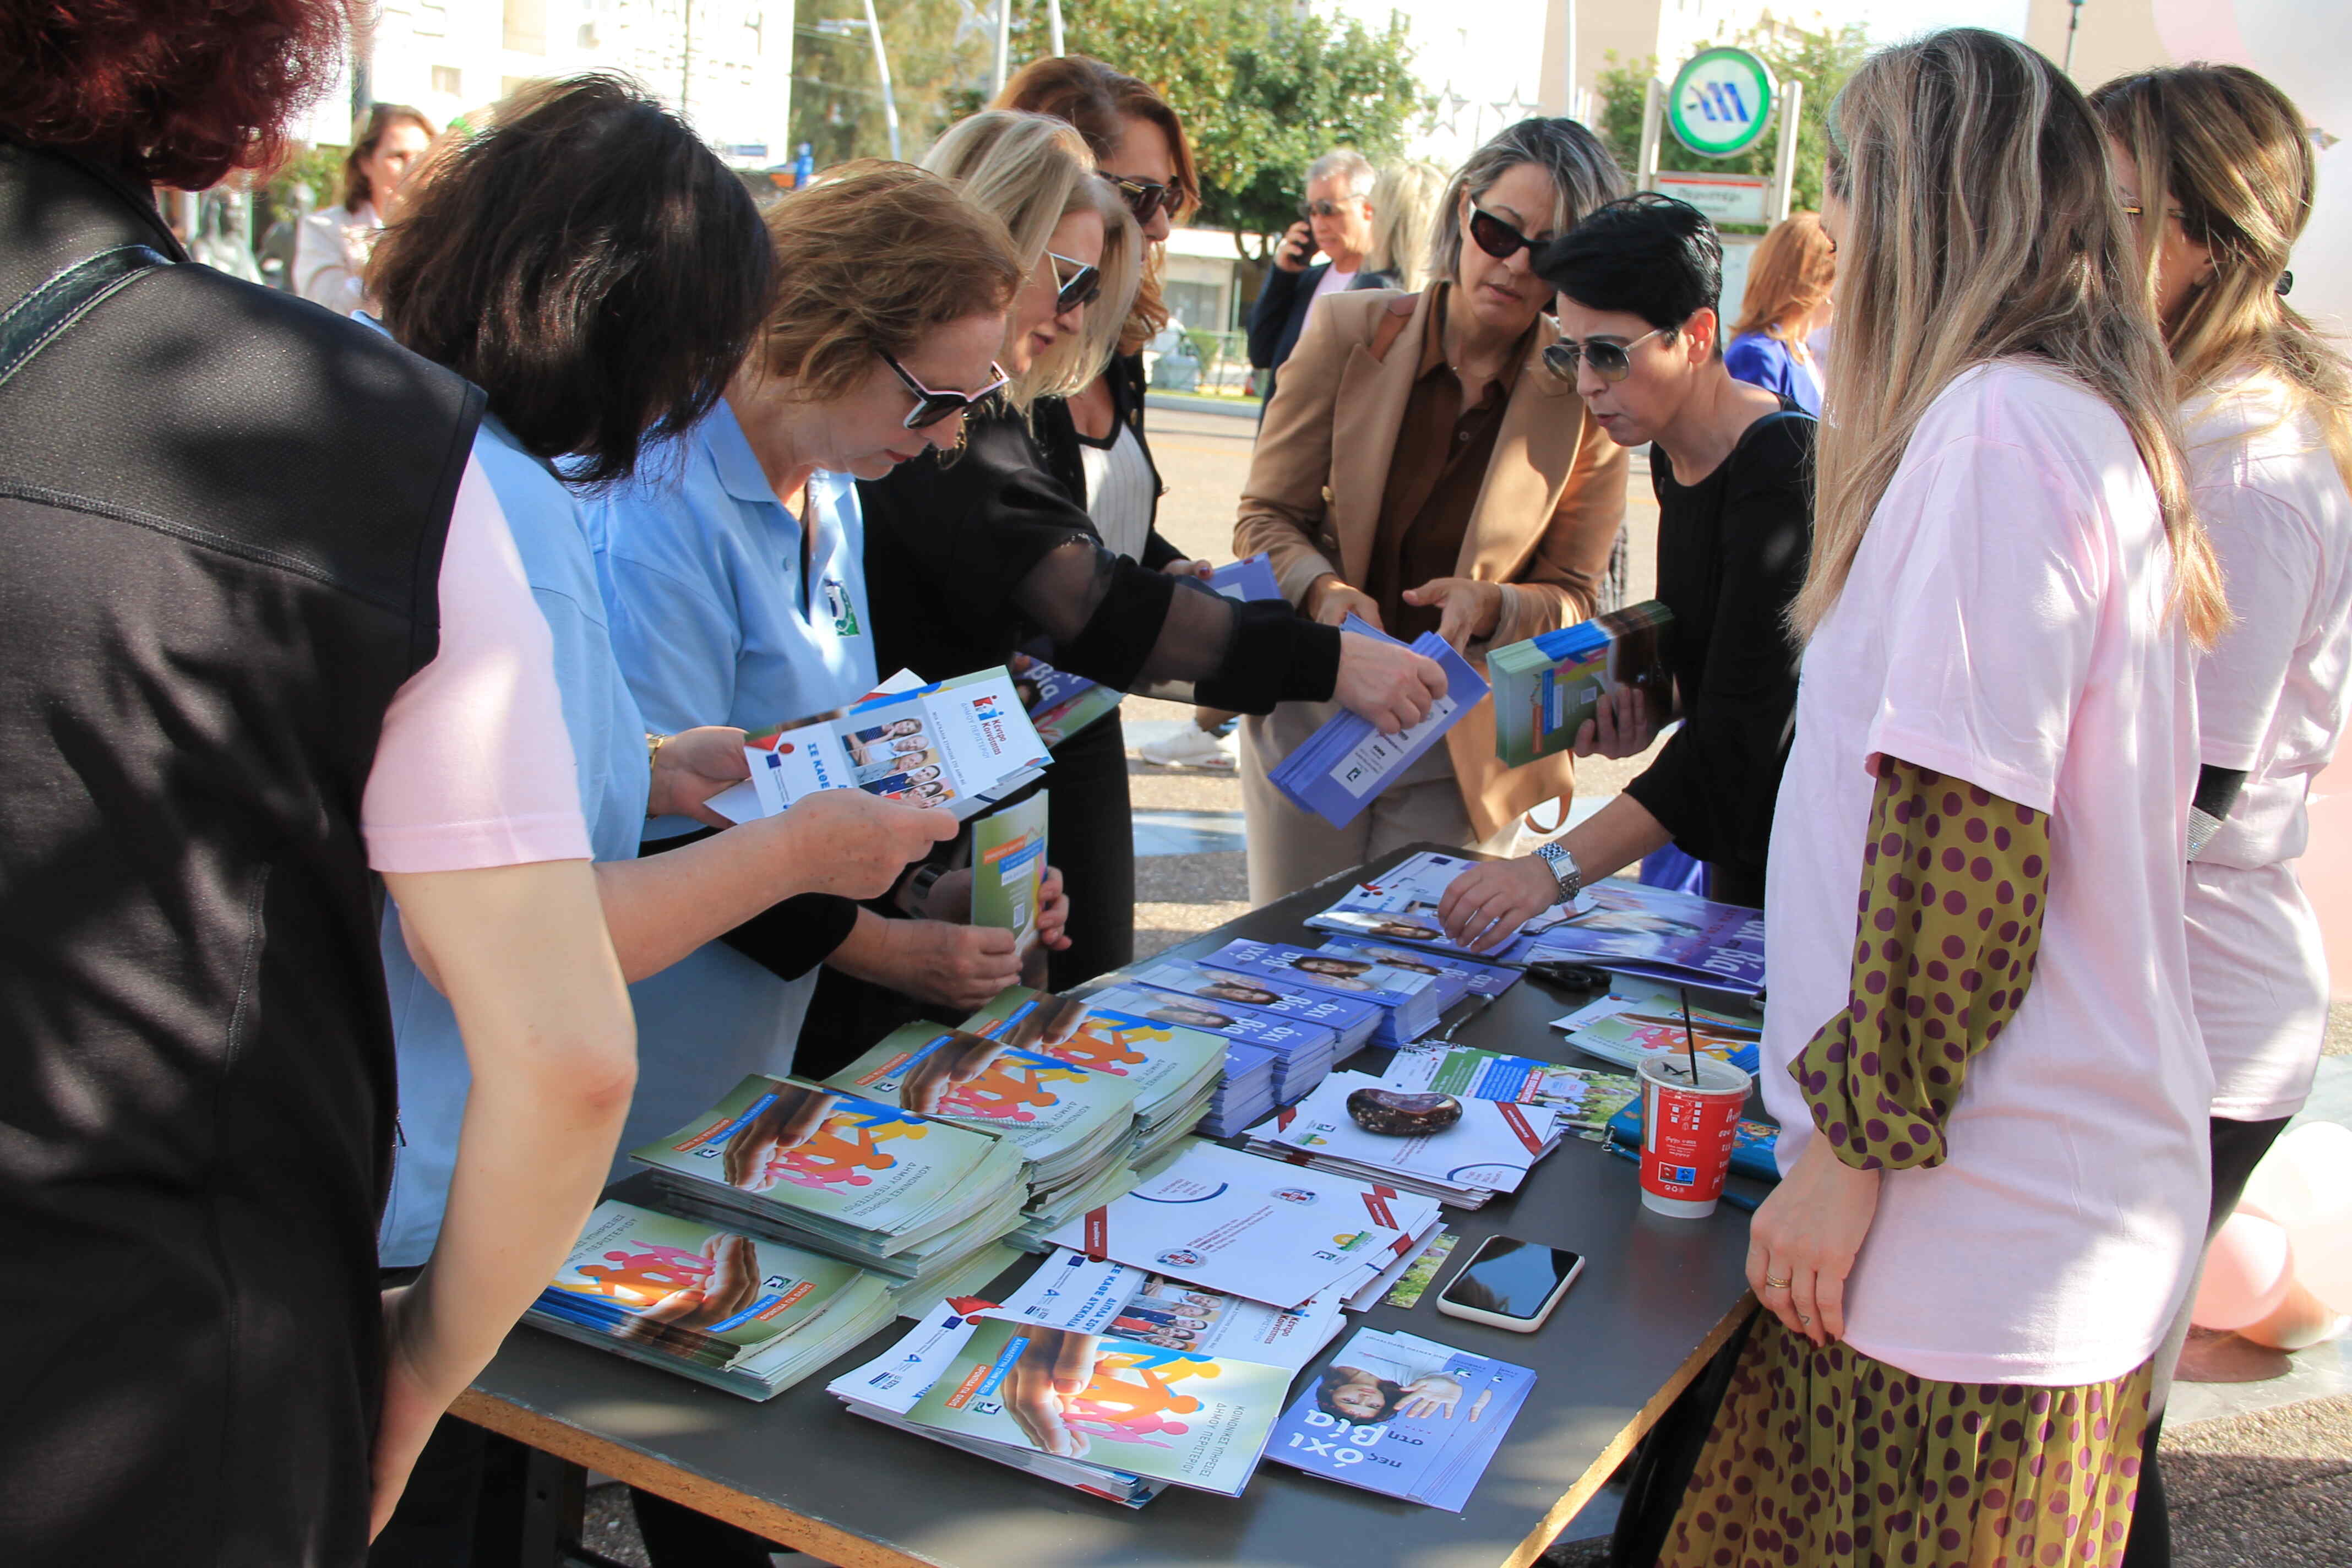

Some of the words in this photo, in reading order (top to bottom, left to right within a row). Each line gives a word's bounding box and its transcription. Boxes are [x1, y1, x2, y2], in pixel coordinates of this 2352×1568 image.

[982, 722, 1002, 755] Κοινότητας
[992, 719, 1006, 742] Κέντρο
[807, 743, 820, 758] ΣΕ
[813, 759, 830, 789] ΚΑΘΕ
[1229, 945, 1269, 962] όχι
[1261, 951, 1304, 970] βία
[1702, 945, 1765, 972] βία
[1267, 993, 1313, 1011] βία
[1303, 1003, 1347, 1018] όχι
[1219, 1016, 1267, 1035] βία
[1257, 1026, 1303, 1042] όχι
[889, 1161, 917, 1184] ΔΗΜΟΥ
[841, 1184, 891, 1212] ΠΕΡΙΣΤΕΡΙΟΥ
[854, 1196, 894, 1217] ΥΠΗΡΕΣΙΕΣ
[585, 1213, 626, 1240] ΥΠΗΡΕΣΙΕΣ
[585, 1218, 639, 1252] ΠΕΡΙΣΤΕΡΙΟΥ
[1092, 1275, 1115, 1296] ΚΑΘΕ
[1065, 1295, 1098, 1329] ΔΥΣΚΟΛΙΑ
[1093, 1297, 1118, 1318] ΔΙΠΛΑ
[1082, 1318, 1100, 1332] ΣΟΥ
[1264, 1314, 1289, 1344] Κοινότητας
[1282, 1316, 1300, 1337] Κέντρο
[1205, 1402, 1227, 1429] ΔΗΜΟΥ
[1304, 1408, 1389, 1447] βία
[1388, 1429, 1424, 1446] στη
[1180, 1430, 1212, 1474] ΠΕΡΙΣΤΕΡΙΟΥ
[1200, 1445, 1225, 1477] ΥΠΗΡΕΣΙΕΣ
[1287, 1431, 1364, 1469] όχι
[1366, 1452, 1403, 1469] πες
